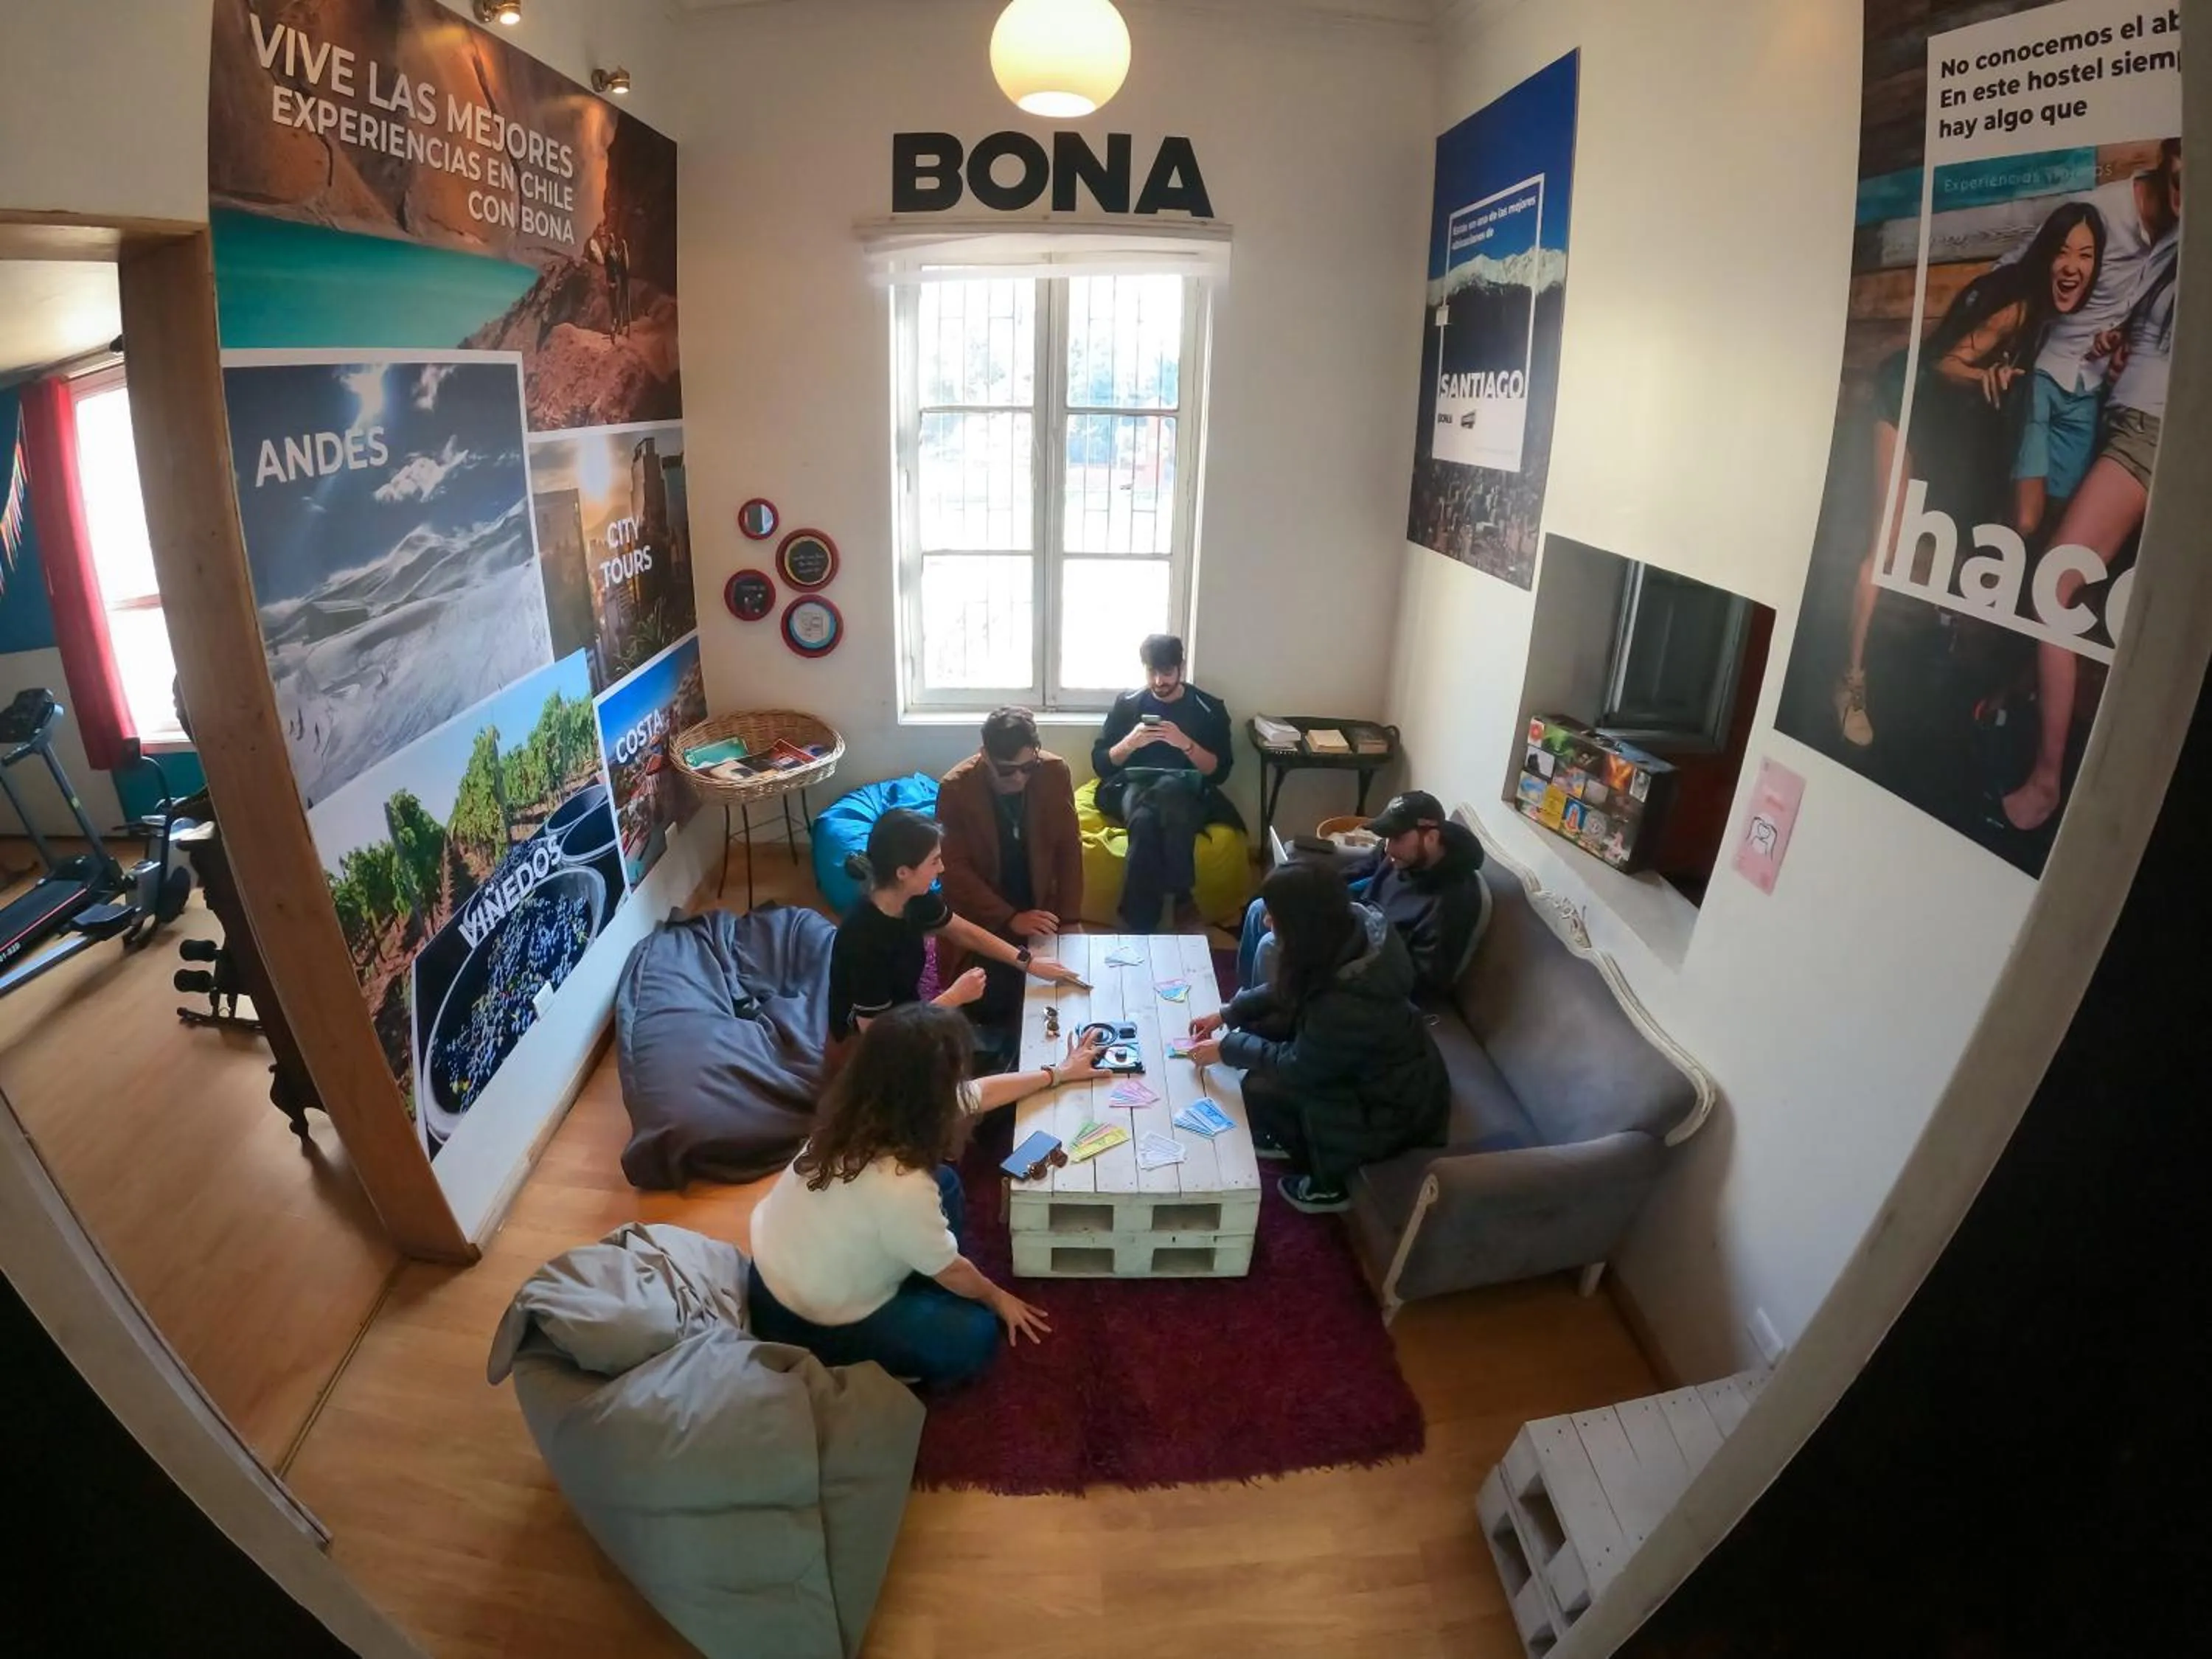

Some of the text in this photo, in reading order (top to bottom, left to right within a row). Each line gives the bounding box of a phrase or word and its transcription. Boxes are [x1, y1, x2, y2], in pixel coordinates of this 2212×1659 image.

[1941, 59, 1969, 78] No
[1975, 26, 2112, 70] conocemos
[2121, 15, 2143, 39] el
[248, 13, 573, 178] VIVE LAS MEJORES
[1940, 50, 2180, 108] En este hostel siem
[1939, 99, 2087, 139] hay algo que
[272, 85, 573, 212] EXPERIENCIAS EN CHILE
[892, 131, 1214, 218] BONA
[468, 190, 574, 245] CON BONA
[1439, 370, 1524, 400] SANTIAGO
[256, 426, 389, 487] ANDES
[607, 515, 639, 549] CITY
[599, 545, 653, 588] TOURS
[616, 708, 663, 763] COSTA
[458, 835, 561, 948] VIÑEDOS
